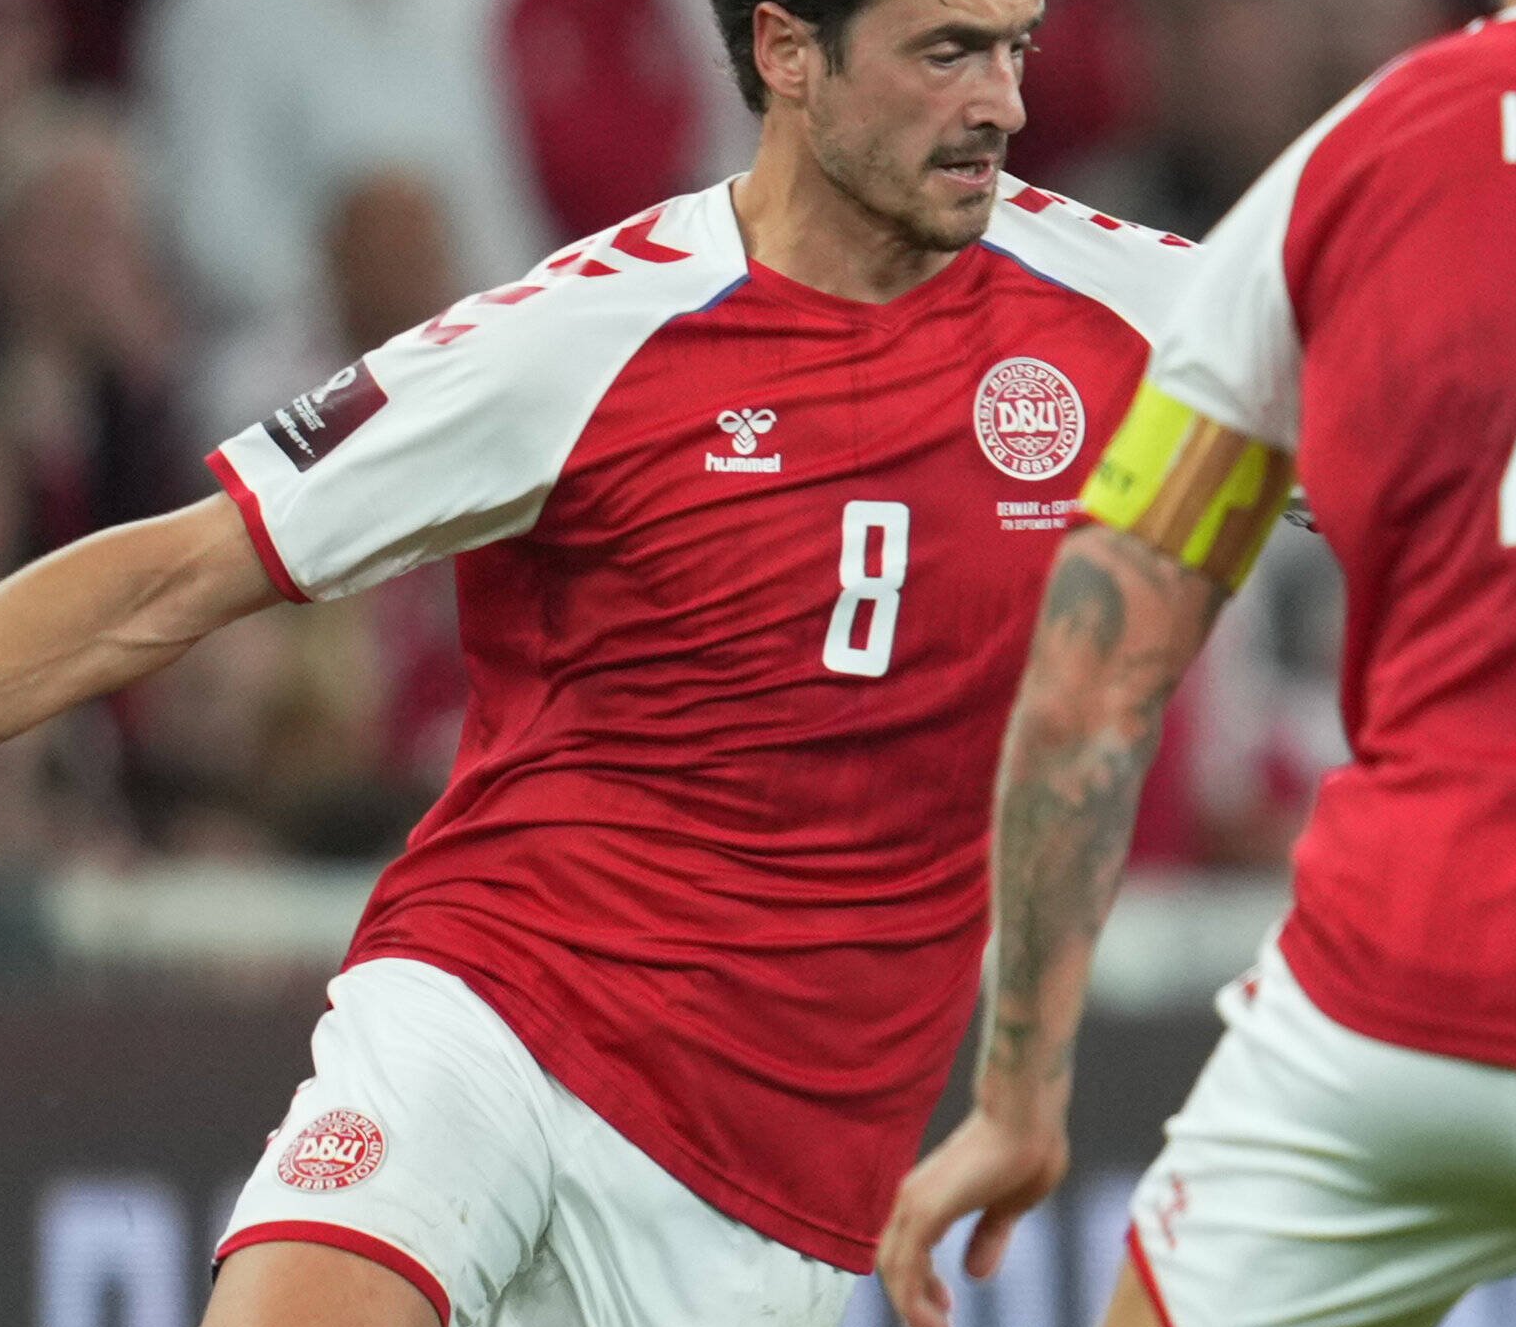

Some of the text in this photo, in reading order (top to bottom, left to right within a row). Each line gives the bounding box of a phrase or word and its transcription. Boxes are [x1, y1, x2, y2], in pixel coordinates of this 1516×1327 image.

[996, 398, 1059, 434] DBU
[705, 452, 782, 473] hummel
[1010, 456, 1055, 474] 1889
[821, 499, 910, 678] 8
[295, 1134, 364, 1164] DBU
